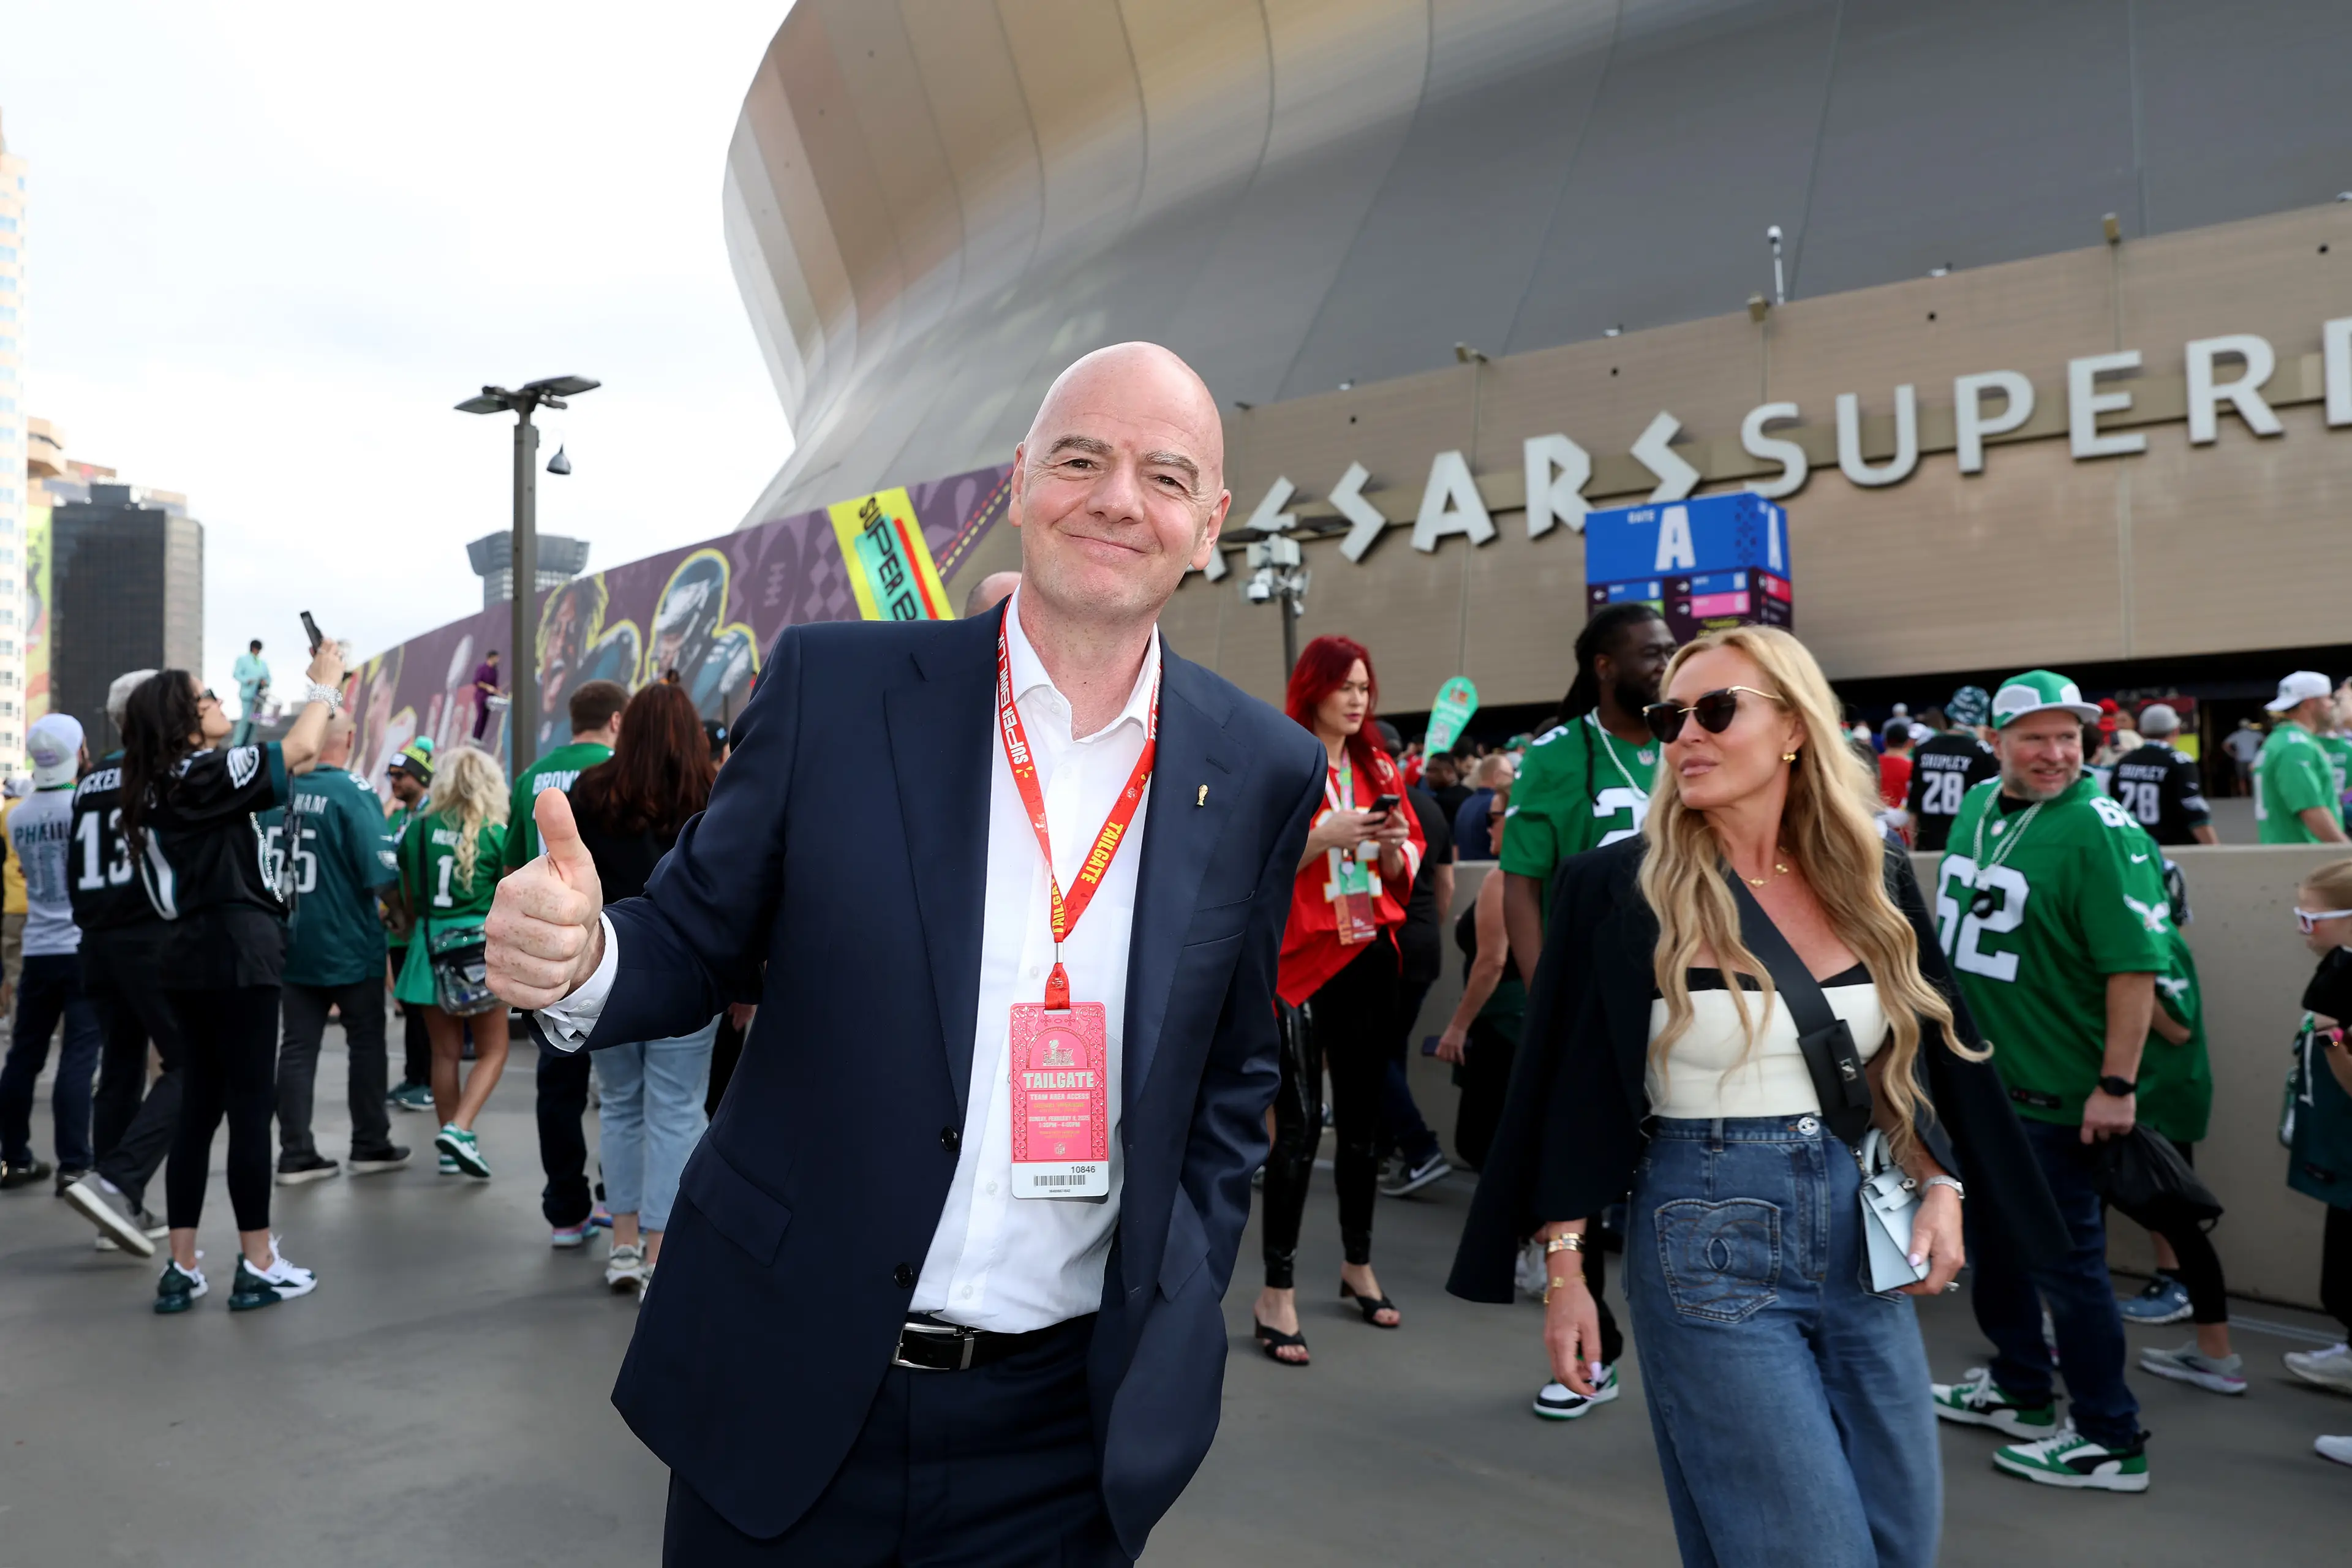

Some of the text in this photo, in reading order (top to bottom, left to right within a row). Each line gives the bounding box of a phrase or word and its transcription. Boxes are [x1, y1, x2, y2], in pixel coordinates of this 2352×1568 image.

[1187, 410, 1702, 582] ESARS
[1654, 505, 1696, 571] A
[859, 497, 905, 597] SUPER
[997, 631, 1029, 765] SUPER BOWL LIX
[1921, 771, 1965, 815] 28
[75, 807, 133, 891] 13
[1080, 821, 1124, 884] TAILGATE
[1936, 854, 2030, 982] 62
[1022, 1072, 1095, 1089] TAILGATE
